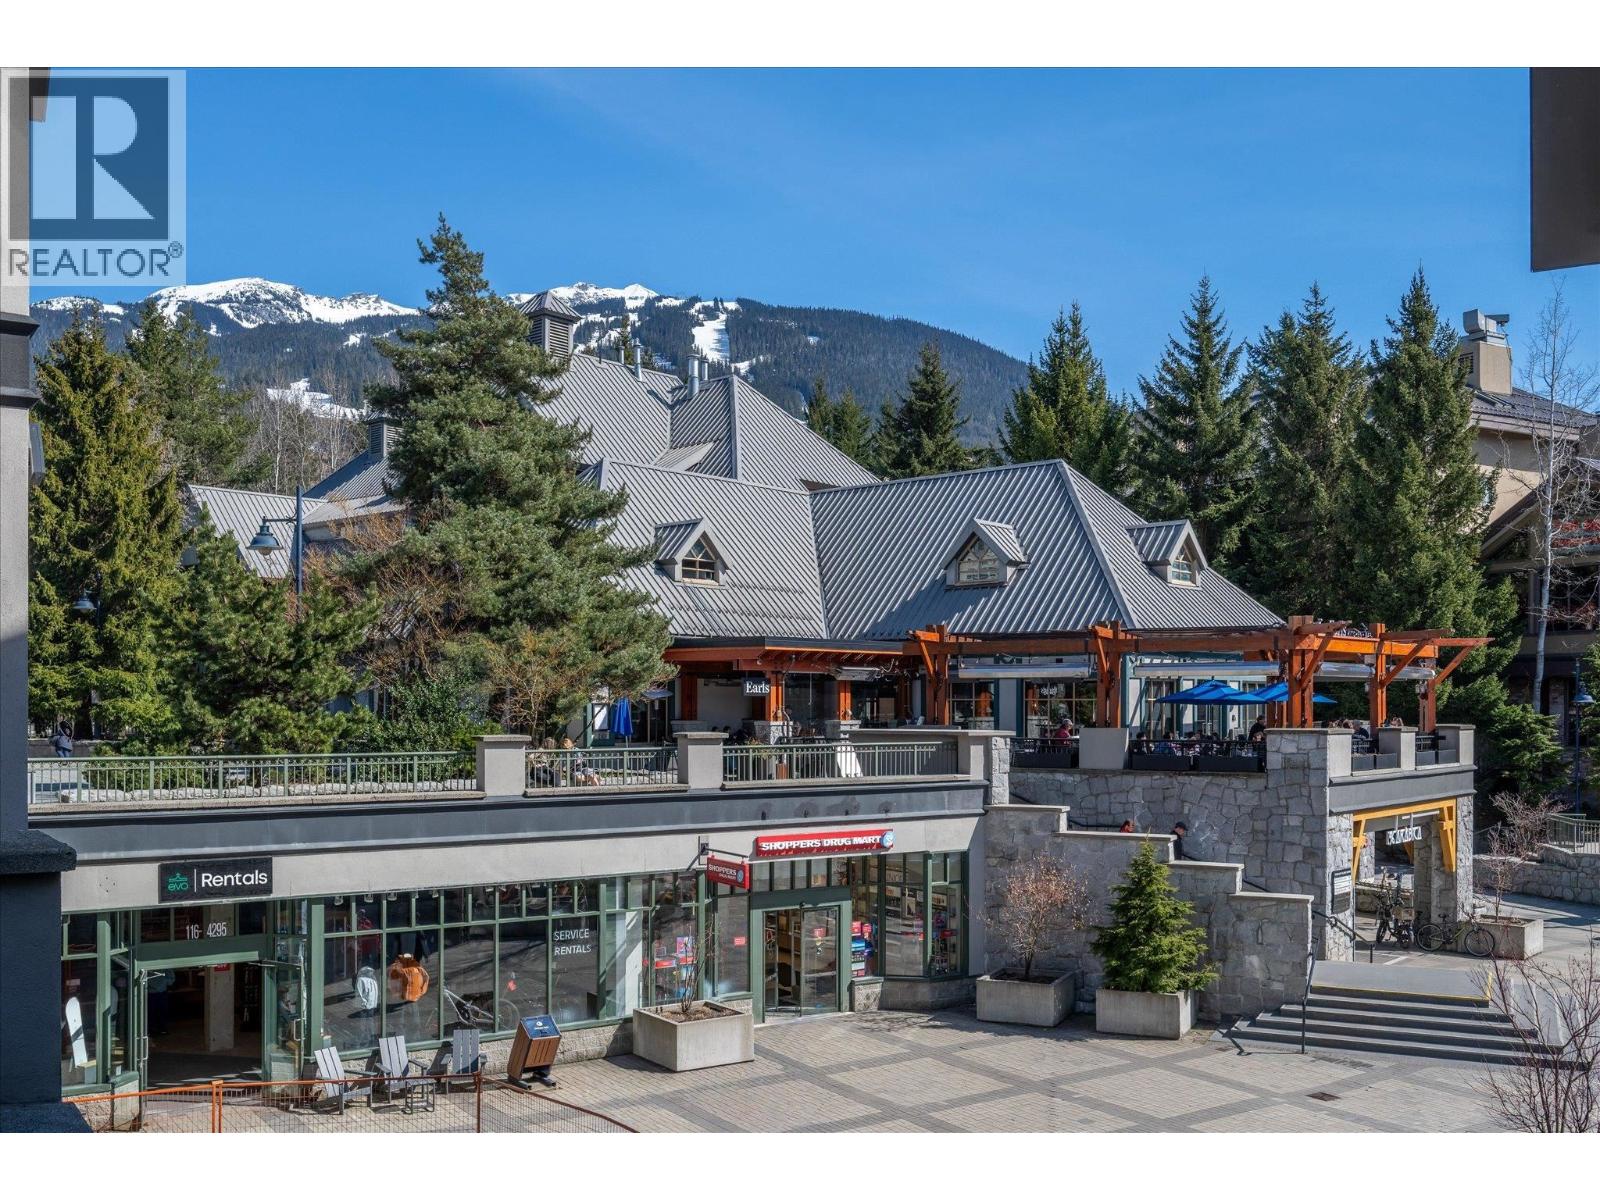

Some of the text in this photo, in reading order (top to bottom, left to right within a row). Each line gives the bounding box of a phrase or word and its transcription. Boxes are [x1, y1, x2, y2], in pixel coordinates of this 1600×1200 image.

[746, 681, 770, 693] Earls
[761, 835, 882, 851] SHOPPERS DRUG MART
[708, 864, 737, 876] SHOPPERS
[201, 869, 268, 888] Rentals
[207, 922, 227, 938] 4295
[554, 929, 590, 941] SERVICE
[554, 945, 592, 956] RENTALS
